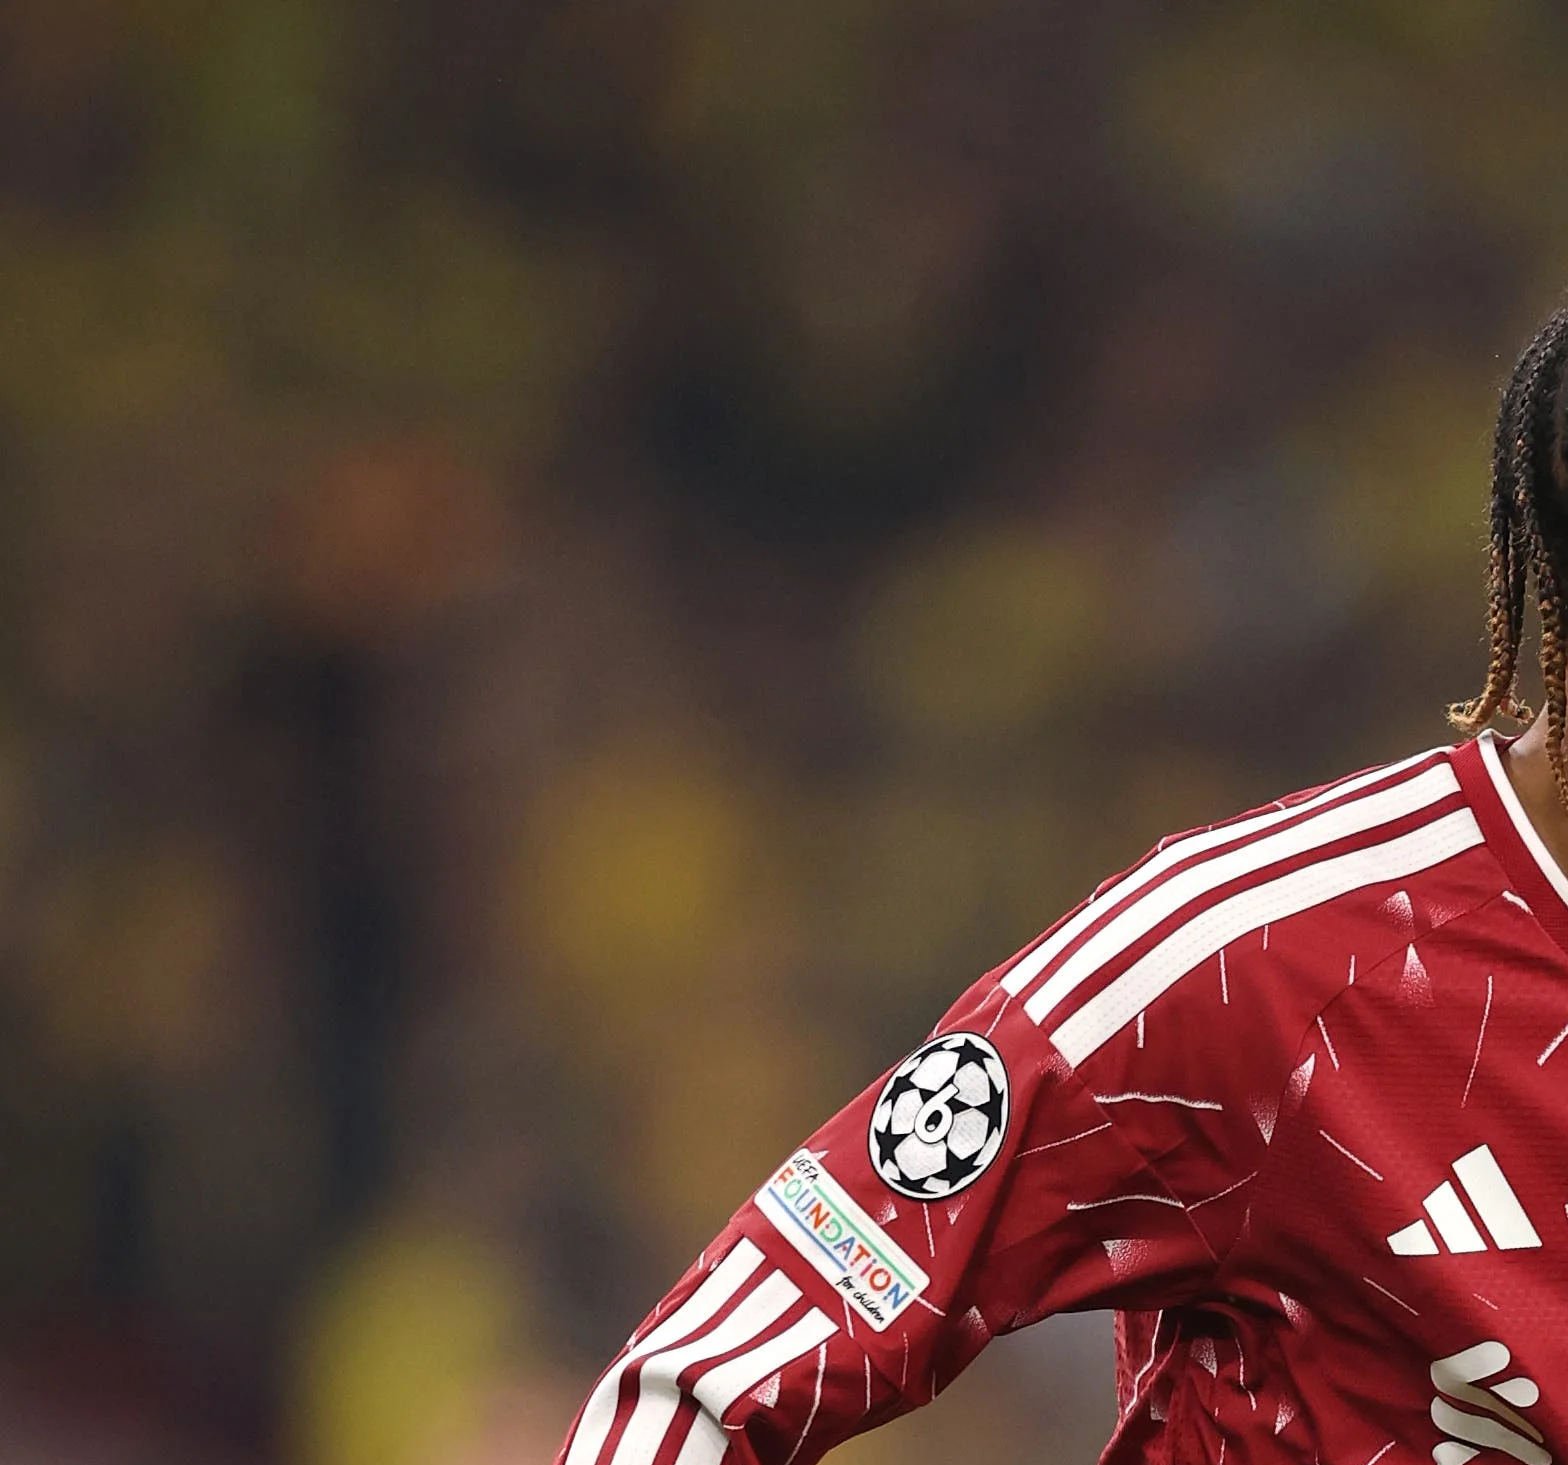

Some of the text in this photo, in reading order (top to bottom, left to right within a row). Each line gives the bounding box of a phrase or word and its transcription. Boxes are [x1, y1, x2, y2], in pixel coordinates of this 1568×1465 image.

[792, 1154, 819, 1183] UEFA
[774, 1166, 909, 1310] FOUNDATION
[835, 1275, 885, 1323] for children
